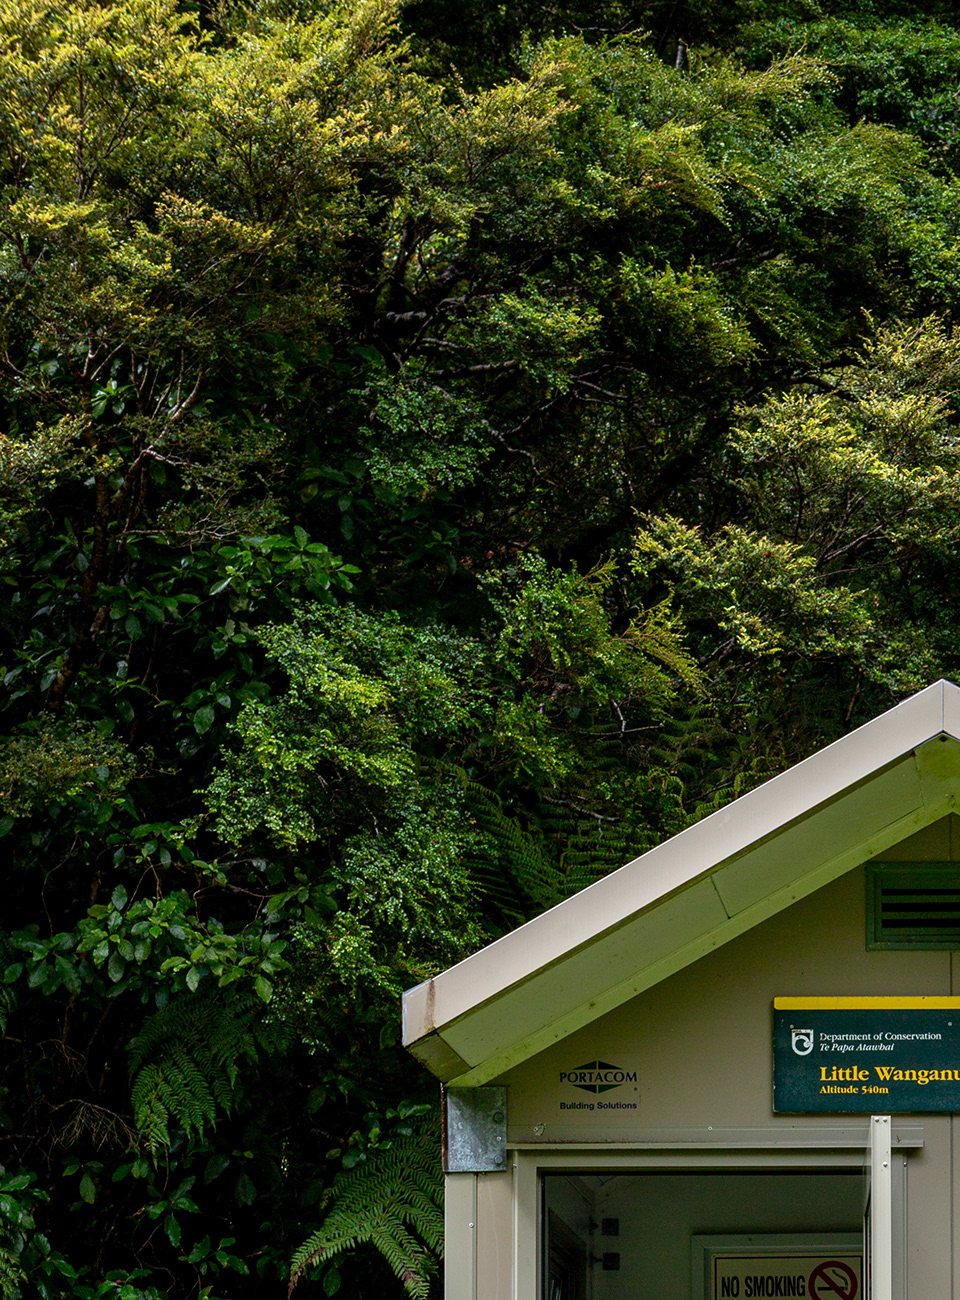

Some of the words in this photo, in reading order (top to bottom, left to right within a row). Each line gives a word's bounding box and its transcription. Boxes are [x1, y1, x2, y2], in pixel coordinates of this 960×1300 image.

[819, 1032, 871, 1042] Department
[873, 1032, 883, 1041] of
[884, 1032, 942, 1041] Conservation
[820, 1043, 830, 1051] Te
[831, 1043, 854, 1053] Papa
[856, 1043, 894, 1051] Atawhai
[560, 1072, 637, 1083] PORTACOM
[819, 1065, 870, 1081] Little
[819, 1085, 859, 1094] Altitude
[861, 1085, 889, 1094] 540m
[560, 1102, 595, 1111] Building
[721, 1276, 740, 1298] NO
[745, 1275, 806, 1298] SMOKING
